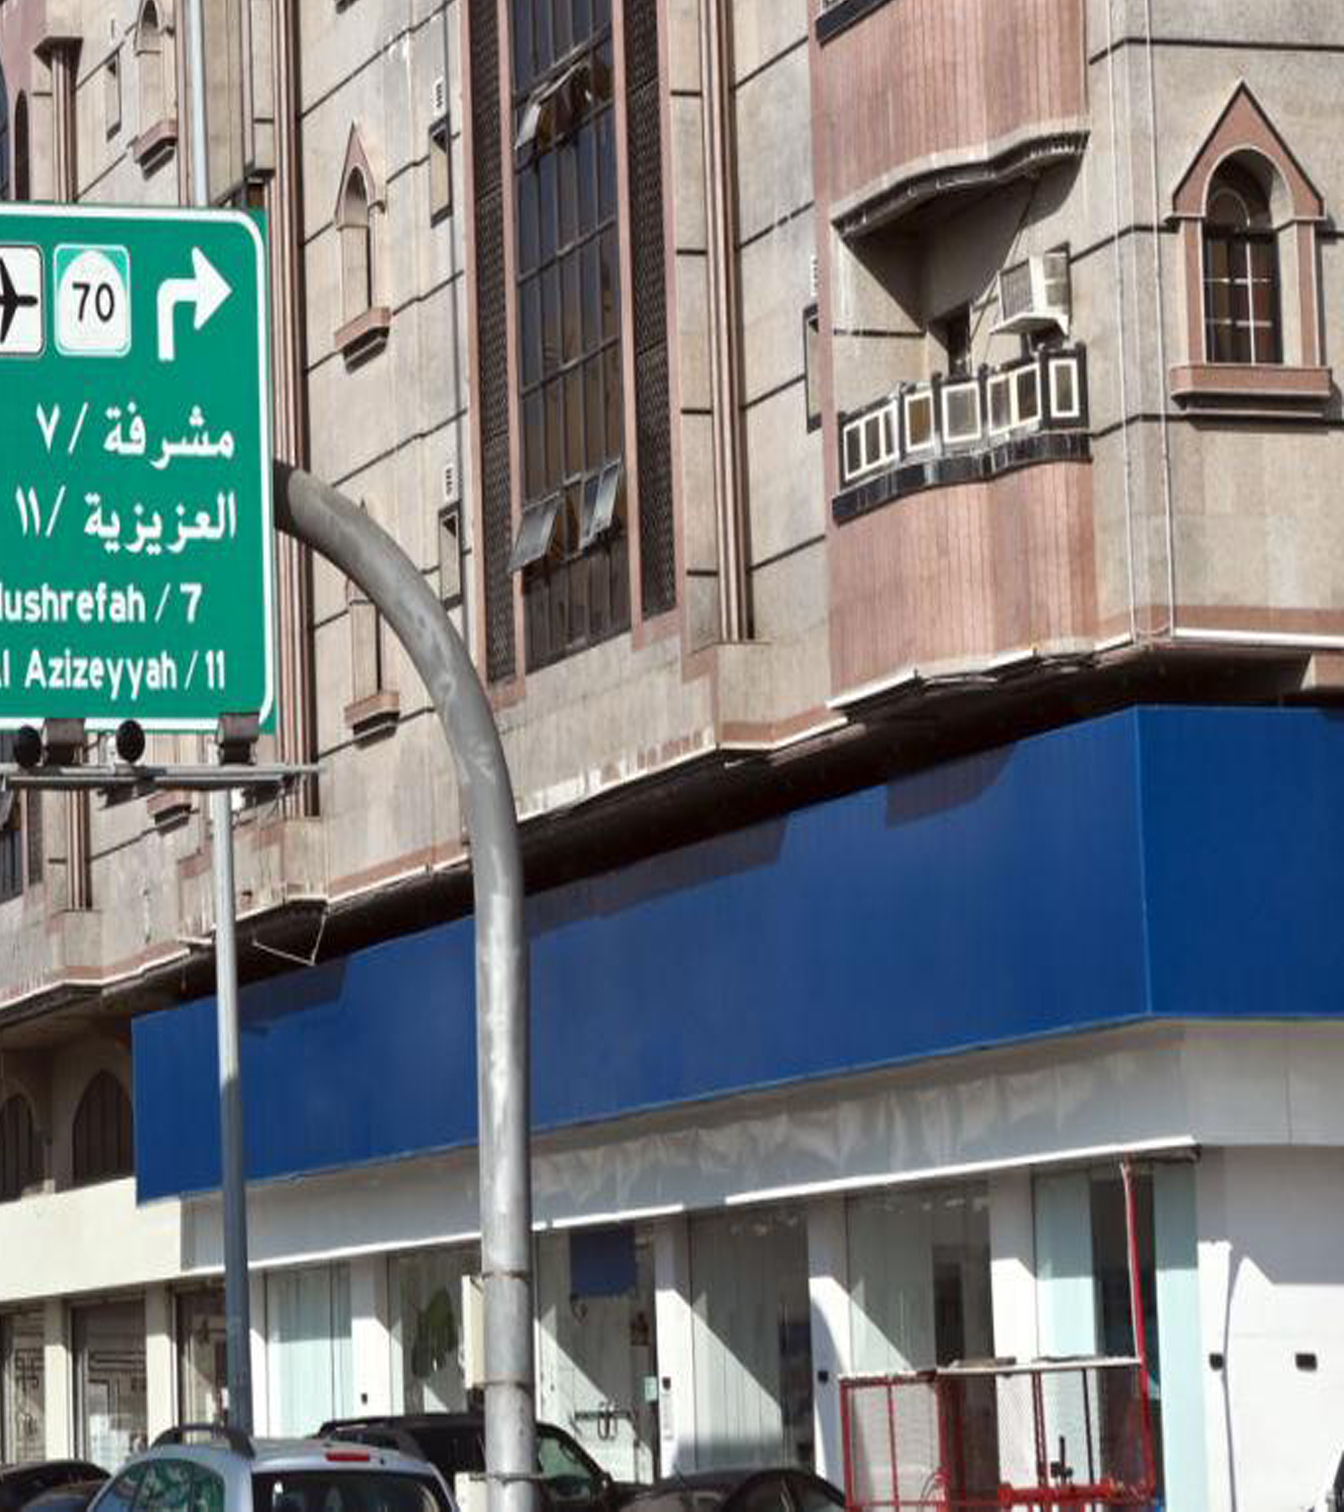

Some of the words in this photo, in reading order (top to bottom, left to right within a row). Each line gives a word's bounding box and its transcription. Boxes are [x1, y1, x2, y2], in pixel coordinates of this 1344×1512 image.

[72, 282, 115, 322] 70
[103, 401, 235, 470] مشرفة
[83, 492, 237, 556] العزيزية
[24, 649, 178, 700] Azizeyyah
